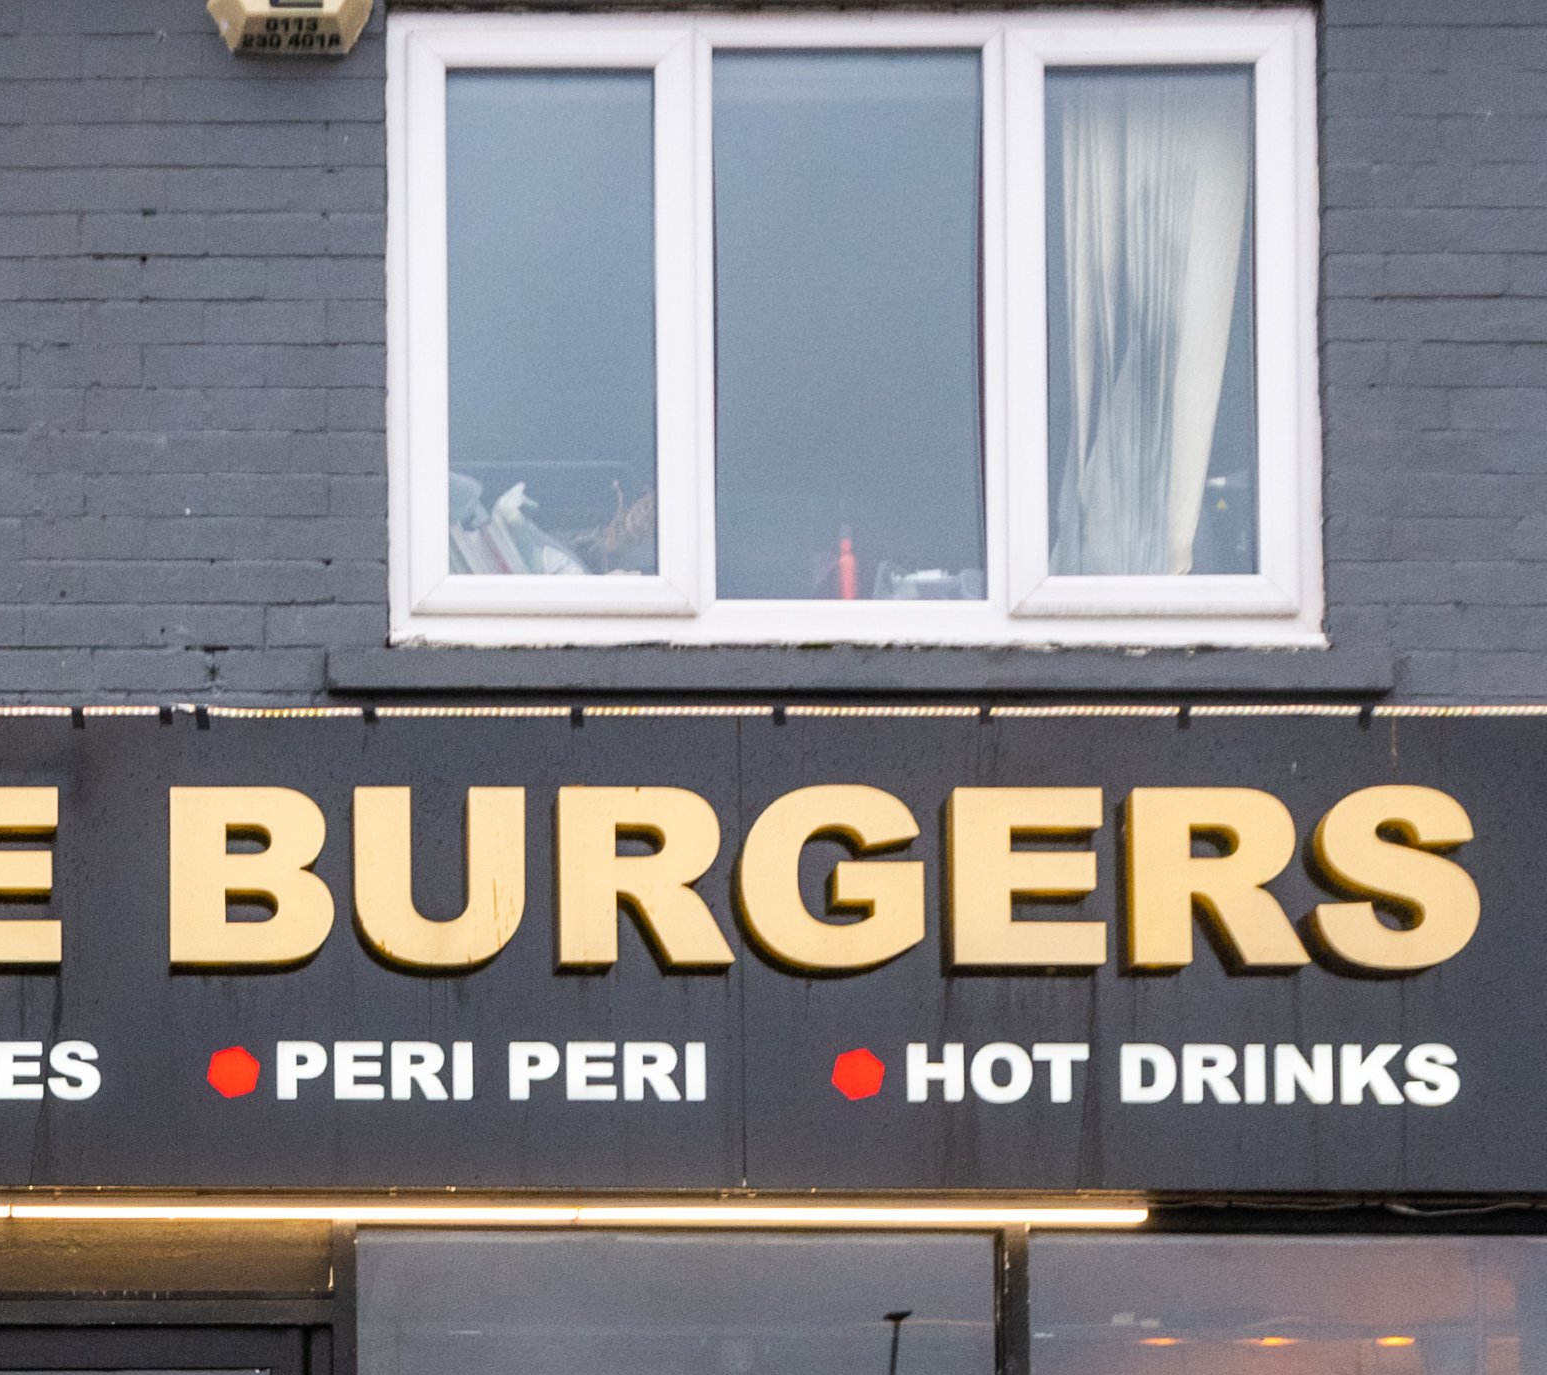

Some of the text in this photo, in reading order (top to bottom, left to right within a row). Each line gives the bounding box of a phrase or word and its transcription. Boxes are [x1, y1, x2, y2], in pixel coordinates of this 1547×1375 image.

[169, 783, 1482, 974] BURGERS
[275, 1041, 707, 1102] PERI PERI
[906, 1042, 1459, 1105] HOT DRINKS
